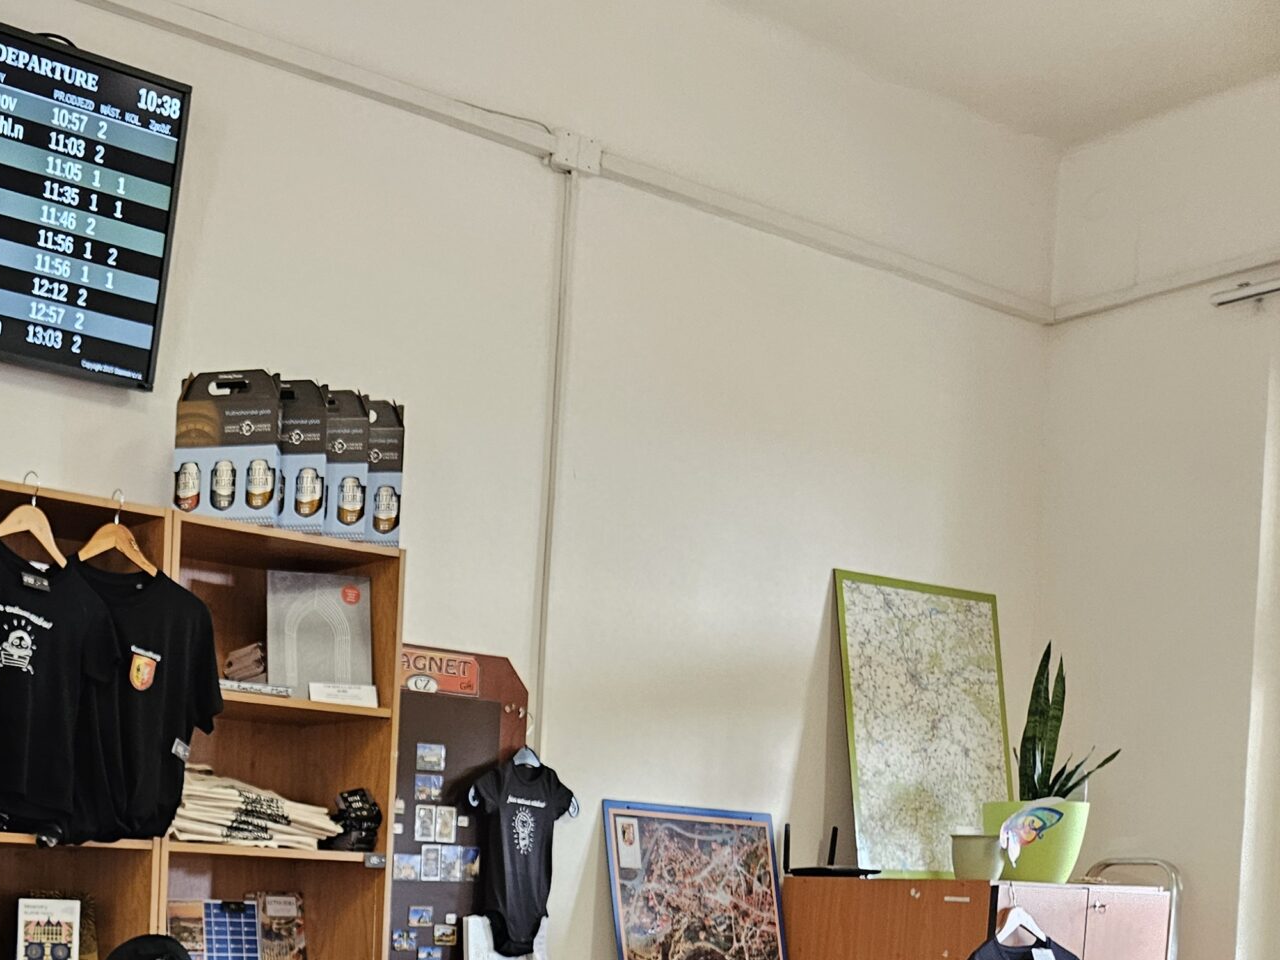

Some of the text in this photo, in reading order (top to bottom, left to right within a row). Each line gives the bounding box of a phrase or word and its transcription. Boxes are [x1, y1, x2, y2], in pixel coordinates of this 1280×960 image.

[138, 88, 181, 119] 10:38
[52, 108, 88, 133] 10:57
[98, 122, 108, 139] 2
[48, 132, 85, 159] 11:03
[95, 146, 104, 164] 2
[46, 156, 82, 182] 11:05
[43, 181, 79, 206] 11:35
[40, 205, 77, 231] 11:46
[86, 218, 96, 235] 2
[37, 229, 74, 254] 11:56
[108, 248, 118, 265] 2
[35, 254, 71, 278] 11:56
[32, 278, 68, 302] 12:12
[78, 289, 87, 306] 2
[29, 302, 66, 326] 12:57
[75, 312, 84, 330] 2
[26, 324, 62, 349] 13:03
[72, 335, 81, 352] 2
[401, 653, 471, 676] AGNET
[414, 679, 430, 690] CZ
